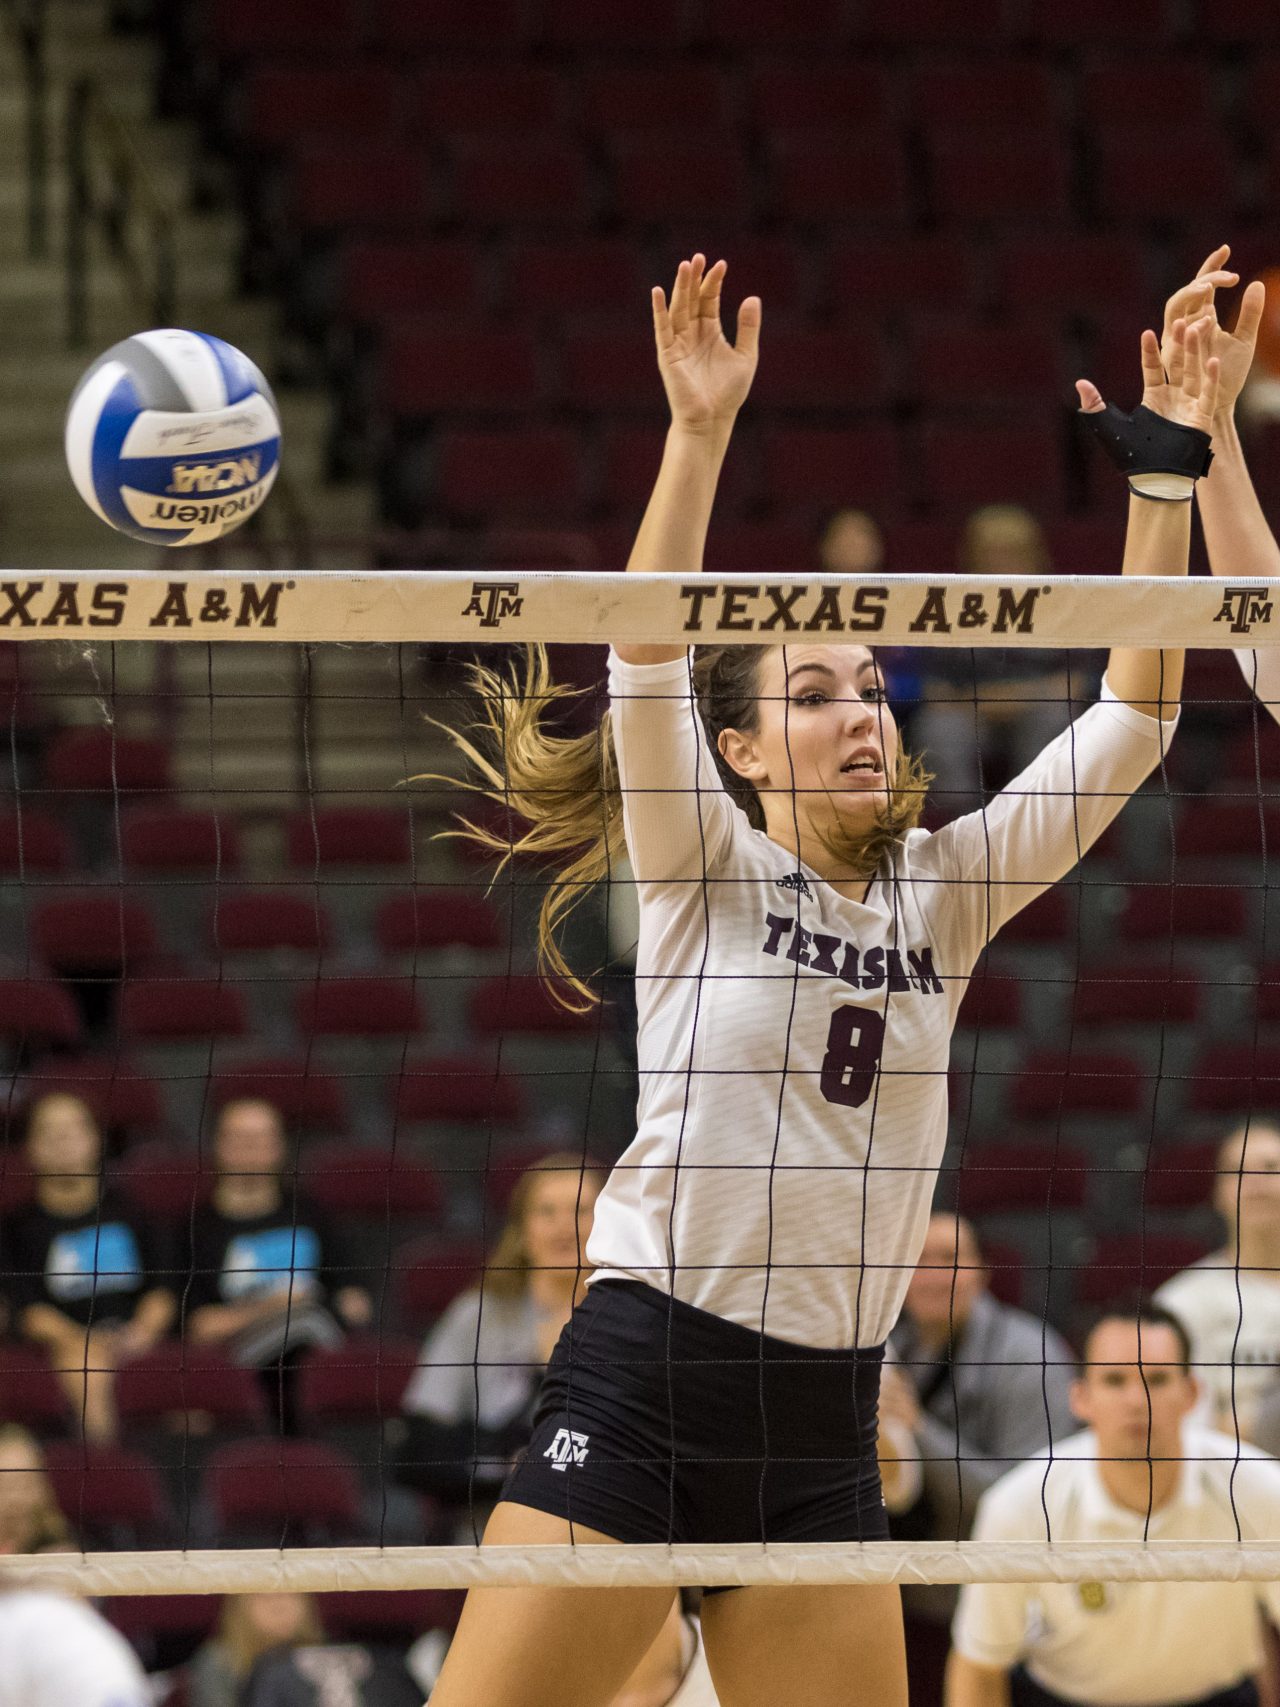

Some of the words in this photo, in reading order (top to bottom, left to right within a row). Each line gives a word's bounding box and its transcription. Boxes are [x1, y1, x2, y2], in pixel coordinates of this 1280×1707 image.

[154, 486, 265, 526] molten
[680, 585, 889, 632] TEXAS
[819, 1004, 886, 1109] 8
